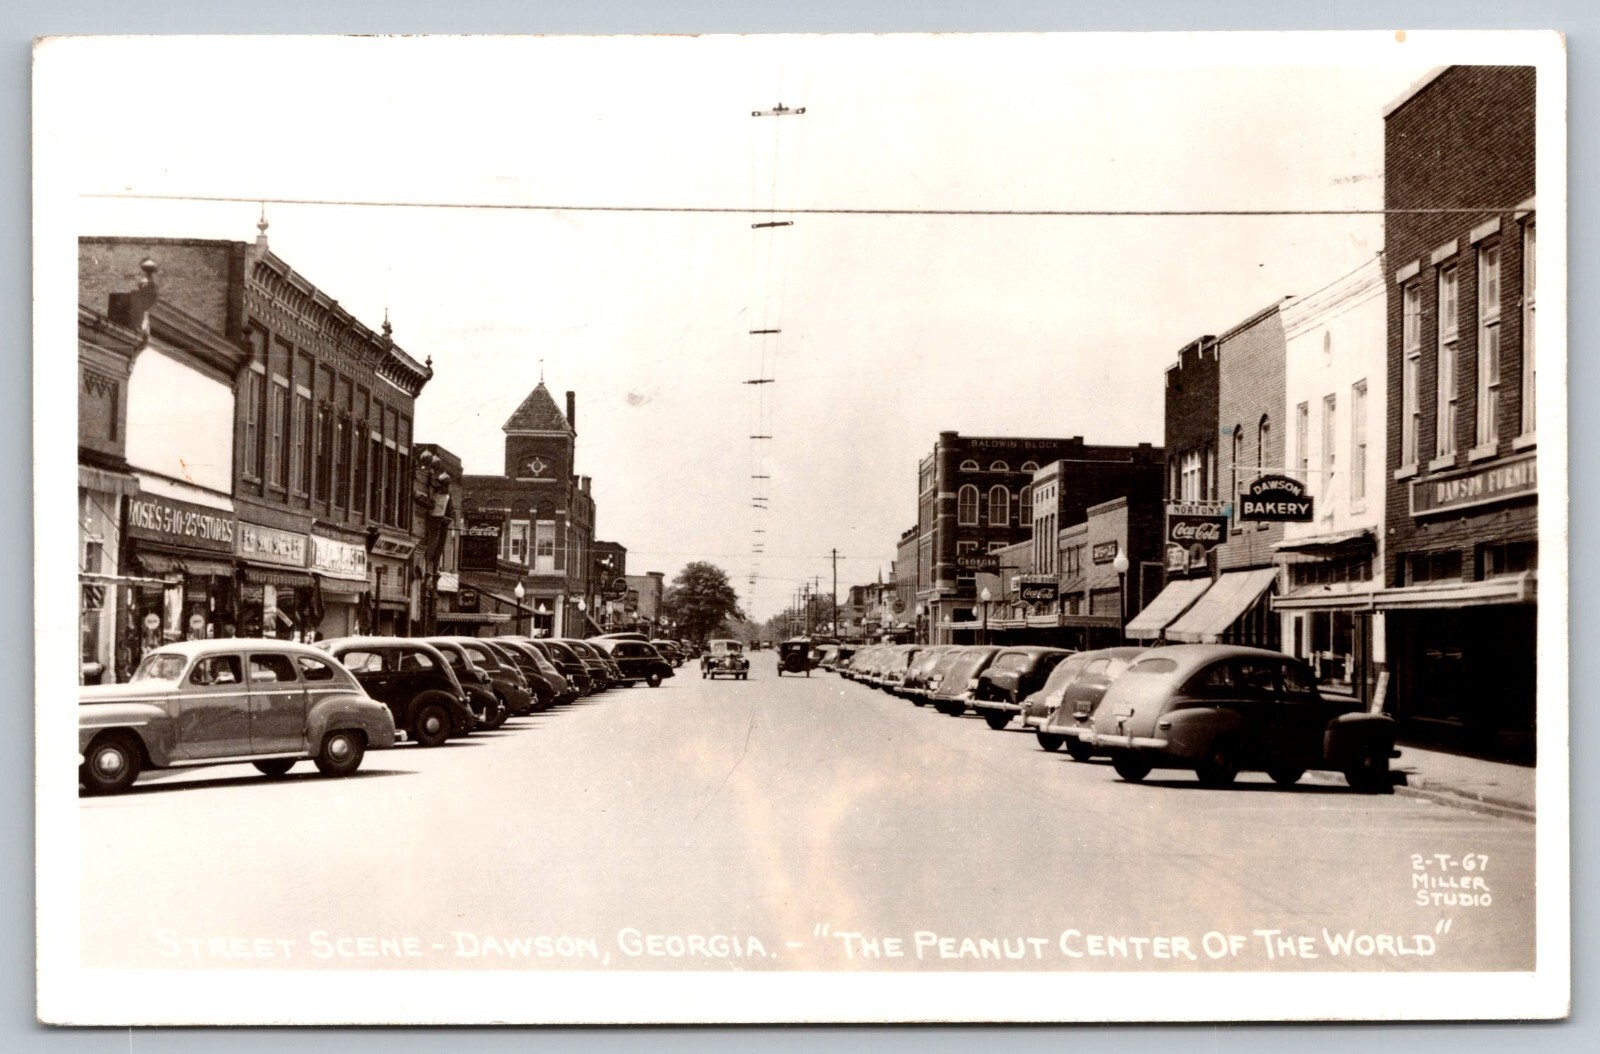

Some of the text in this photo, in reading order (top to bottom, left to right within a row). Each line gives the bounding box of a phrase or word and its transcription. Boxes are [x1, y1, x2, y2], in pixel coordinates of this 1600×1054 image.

[971, 440, 1059, 449] BALDWIN BLOCK
[1253, 480, 1301, 497] DAWSON
[1437, 474, 1483, 503] DAWSON
[1244, 502, 1309, 515] BAKERY
[200, 515, 233, 542] STORES
[1172, 522, 1220, 540] Coca-Cola
